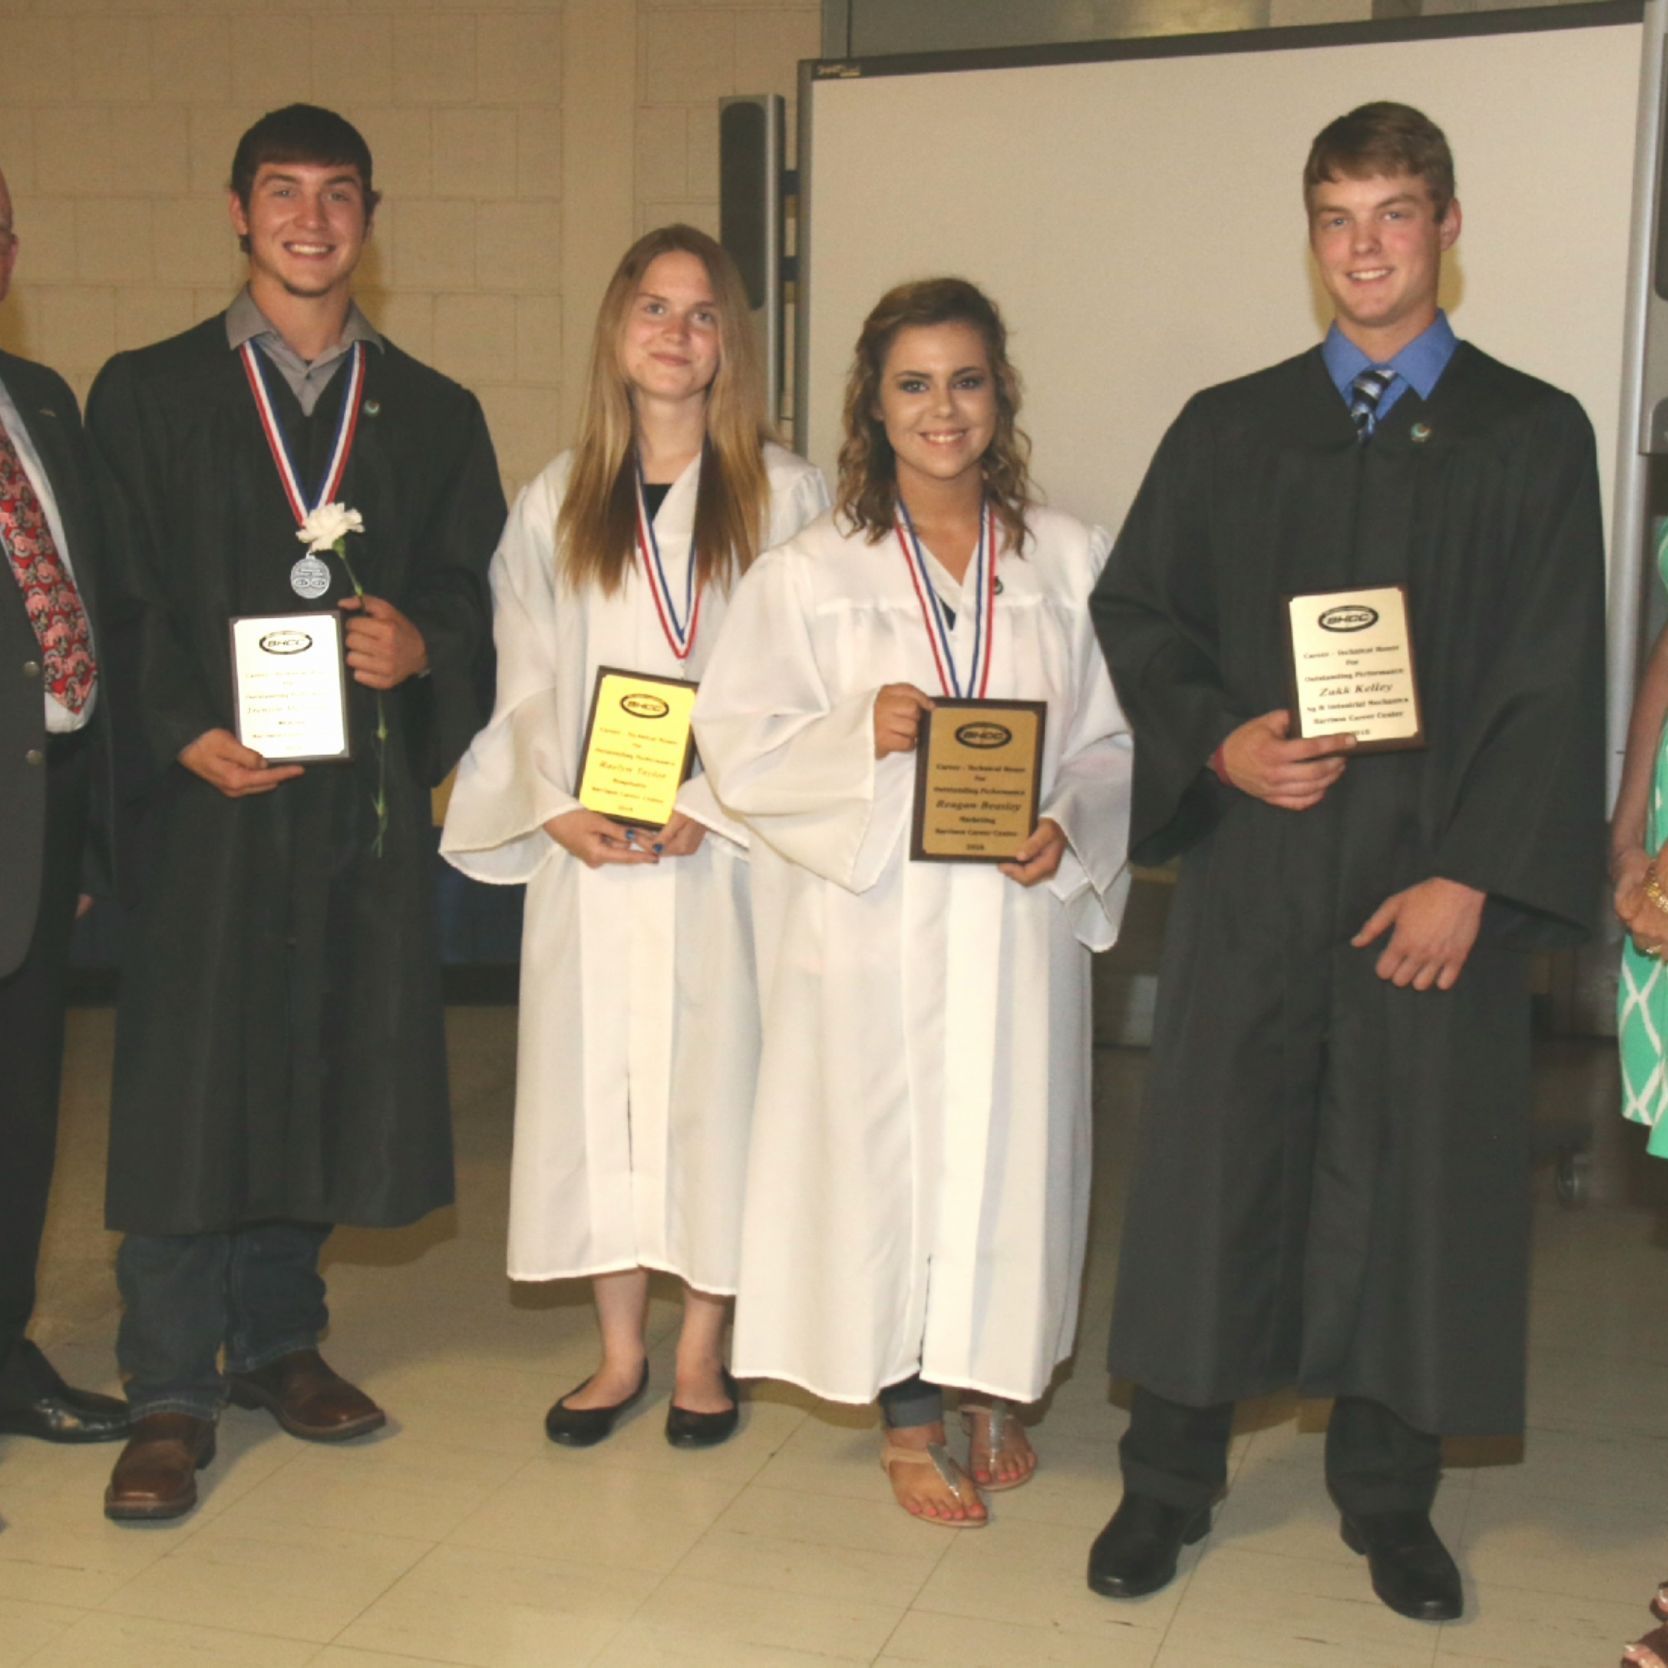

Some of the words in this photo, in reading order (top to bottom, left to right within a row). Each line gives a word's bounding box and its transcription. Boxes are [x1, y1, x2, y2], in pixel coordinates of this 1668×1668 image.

[1303, 652, 1330, 660] Career
[1337, 647, 1373, 657] Technical
[1305, 672, 1353, 683] Outstanding
[1355, 668, 1405, 678] Performance
[1355, 682, 1394, 694] Kelley
[967, 763, 1001, 773] Technical
[933, 786, 978, 796] Outstanding
[980, 787, 1026, 796] Performance
